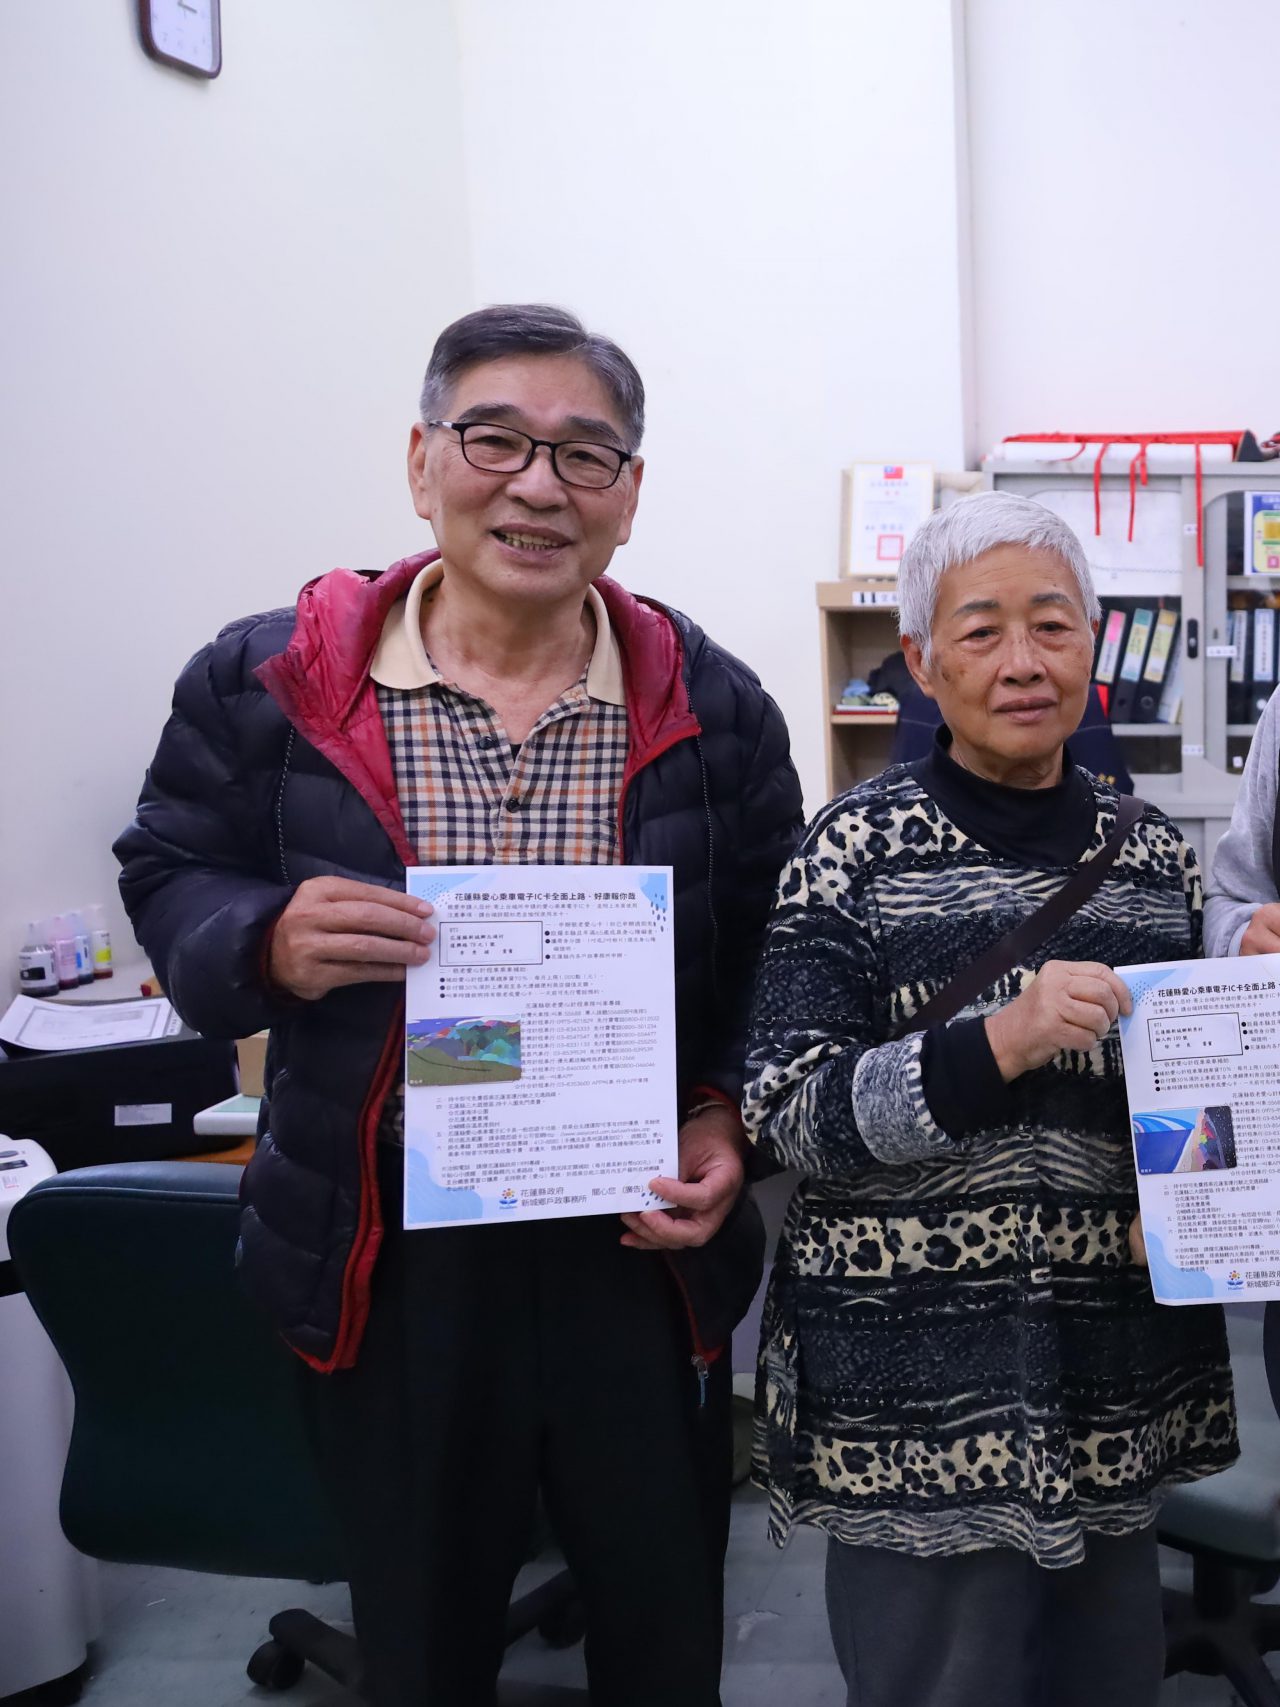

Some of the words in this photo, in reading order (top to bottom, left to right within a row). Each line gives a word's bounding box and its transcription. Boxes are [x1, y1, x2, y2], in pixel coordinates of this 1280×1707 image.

[521, 1187, 564, 1197] 花蓮縣政府
[592, 1188, 616, 1196] 關心您
[521, 1195, 587, 1206] 新城鄉戶政事務所
